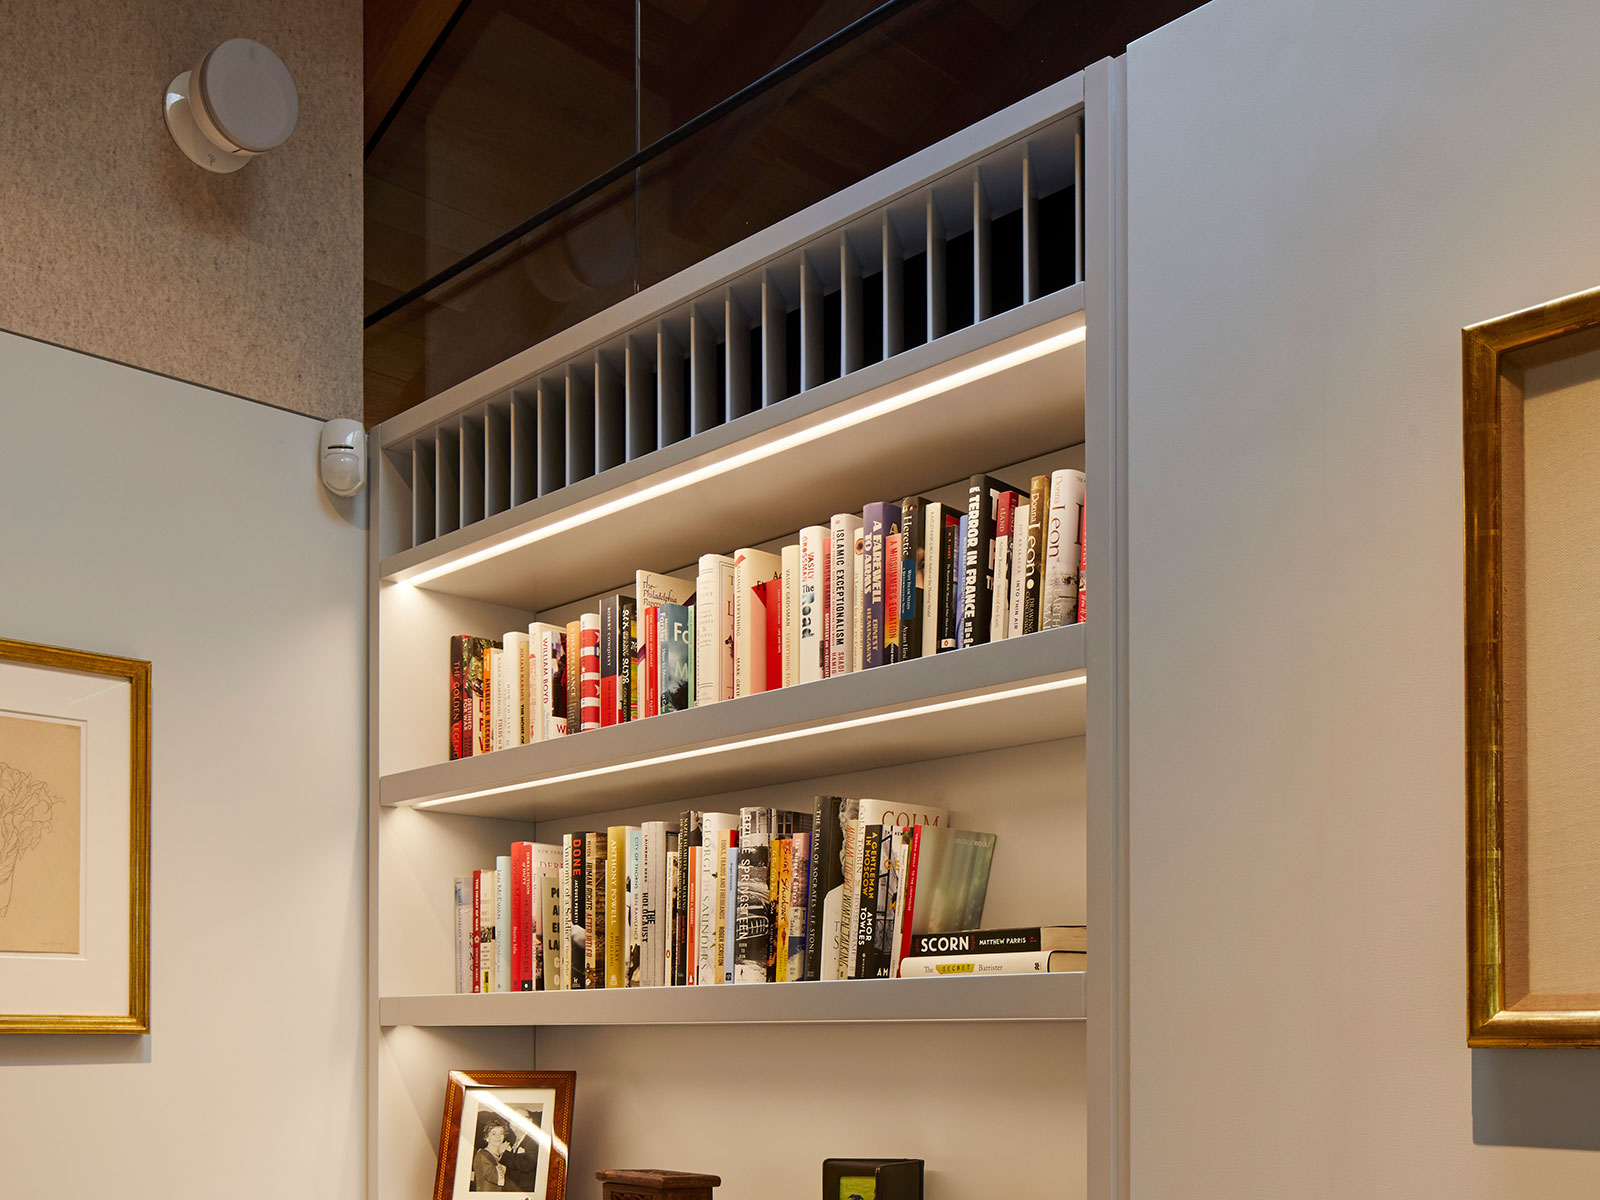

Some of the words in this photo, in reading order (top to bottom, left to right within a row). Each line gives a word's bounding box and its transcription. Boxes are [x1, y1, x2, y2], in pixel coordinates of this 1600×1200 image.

[1030, 493, 1040, 522] Donna
[1054, 475, 1064, 504] Donna
[872, 520, 882, 532] A
[902, 516, 912, 556] Heretic
[967, 494, 980, 548] TERROR
[1048, 505, 1066, 558] Leon
[836, 529, 844, 566] ISLAMIC
[864, 532, 872, 552] TO
[966, 550, 977, 566] IN
[1026, 522, 1041, 576] Leon
[864, 554, 872, 595] ARMS
[872, 534, 882, 604] FAREWELL
[802, 584, 815, 594] The
[836, 569, 844, 646] EXCEPTIONALISM
[964, 568, 976, 618] FRANCE
[801, 592, 815, 639] Road
[888, 602, 897, 639] EQUATION
[452, 681, 460, 720] GOLDEN
[702, 818, 712, 874] GEORGE
[742, 814, 751, 854] BRUCE
[846, 826, 856, 856] MIRIAM
[865, 836, 871, 846] IN
[573, 839, 581, 876] DONE
[782, 845, 792, 874] Burnt
[813, 854, 819, 865] OF
[862, 850, 871, 896] MOSCOW
[868, 841, 878, 899] GENTLEMAN
[738, 859, 751, 940] SPRINGSTEEN
[780, 878, 791, 922] Shadows
[811, 867, 819, 908] SOCRATES
[648, 910, 656, 925] THE
[841, 894, 852, 926] WOMEN
[858, 907, 868, 946] TOWLES
[864, 912, 873, 942] AMOR
[700, 895, 710, 970] SAUNDERS
[840, 927, 850, 967] TALKING
[920, 936, 970, 952] SCORN
[979, 938, 1005, 946] MATTHEW
[1006, 937, 1027, 945] PARRIS
[924, 966, 934, 974] The
[942, 964, 971, 973] SECRET
[978, 964, 1003, 972] Barrister
